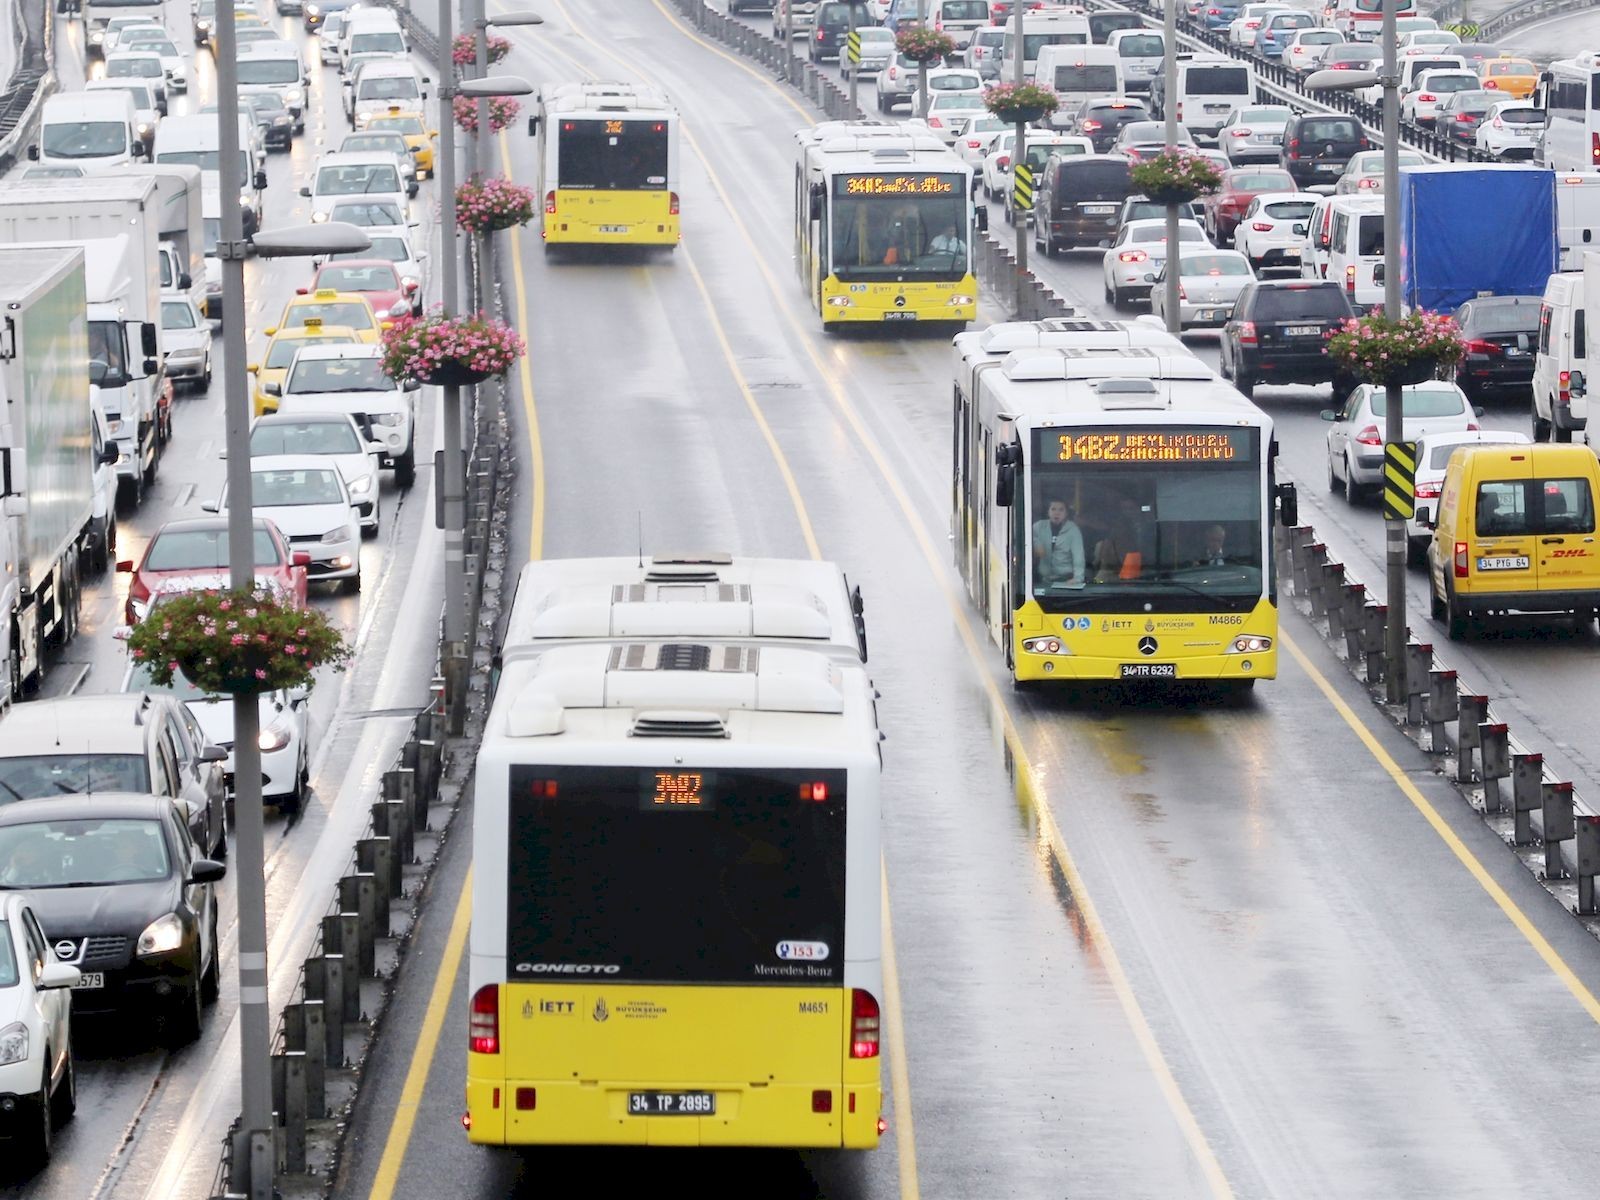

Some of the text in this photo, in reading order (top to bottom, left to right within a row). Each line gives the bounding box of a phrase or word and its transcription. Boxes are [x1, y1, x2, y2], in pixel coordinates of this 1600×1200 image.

[1058, 435, 1120, 461] 34BZ
[1552, 549, 1588, 558] DHL
[1483, 558, 1526, 568] 34 PYG 64
[1209, 615, 1243, 625] M4866
[1122, 665, 1174, 676] 34 TR 6292
[793, 945, 813, 957] 153
[516, 963, 620, 974] CONECTO
[754, 964, 833, 977] Mercedes-Benz
[539, 998, 575, 1013] İETT
[798, 1001, 829, 1014] M4651
[632, 1094, 649, 1111] 34
[656, 1095, 673, 1112] TP
